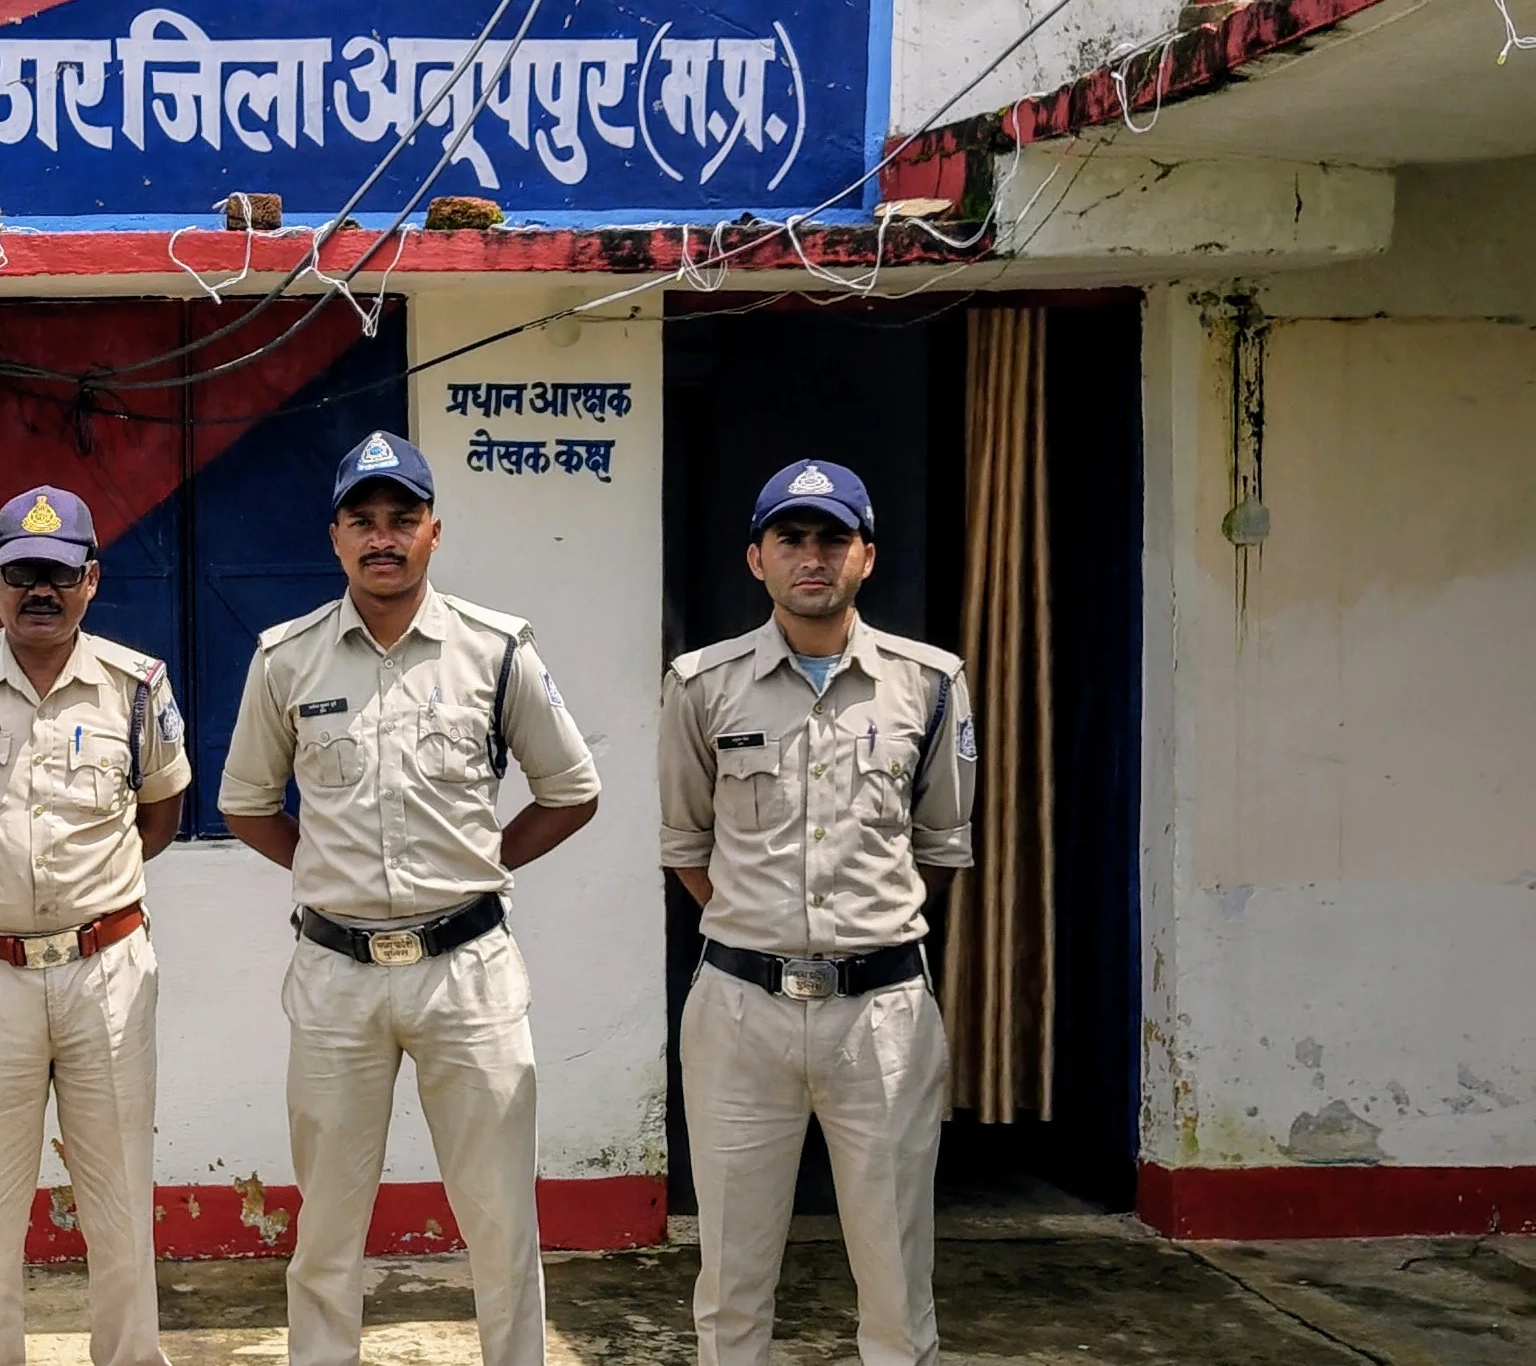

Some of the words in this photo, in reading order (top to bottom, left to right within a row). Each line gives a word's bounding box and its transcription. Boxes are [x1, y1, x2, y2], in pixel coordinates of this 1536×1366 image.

[115, 8, 333, 152] जिला
[334, 35, 638, 190] अनूपपुर
[446, 382, 528, 418] प्रधान
[529, 381, 632, 423] आरक्षक
[467, 428, 551, 475] लेखक
[554, 438, 616, 484] कक्ष
